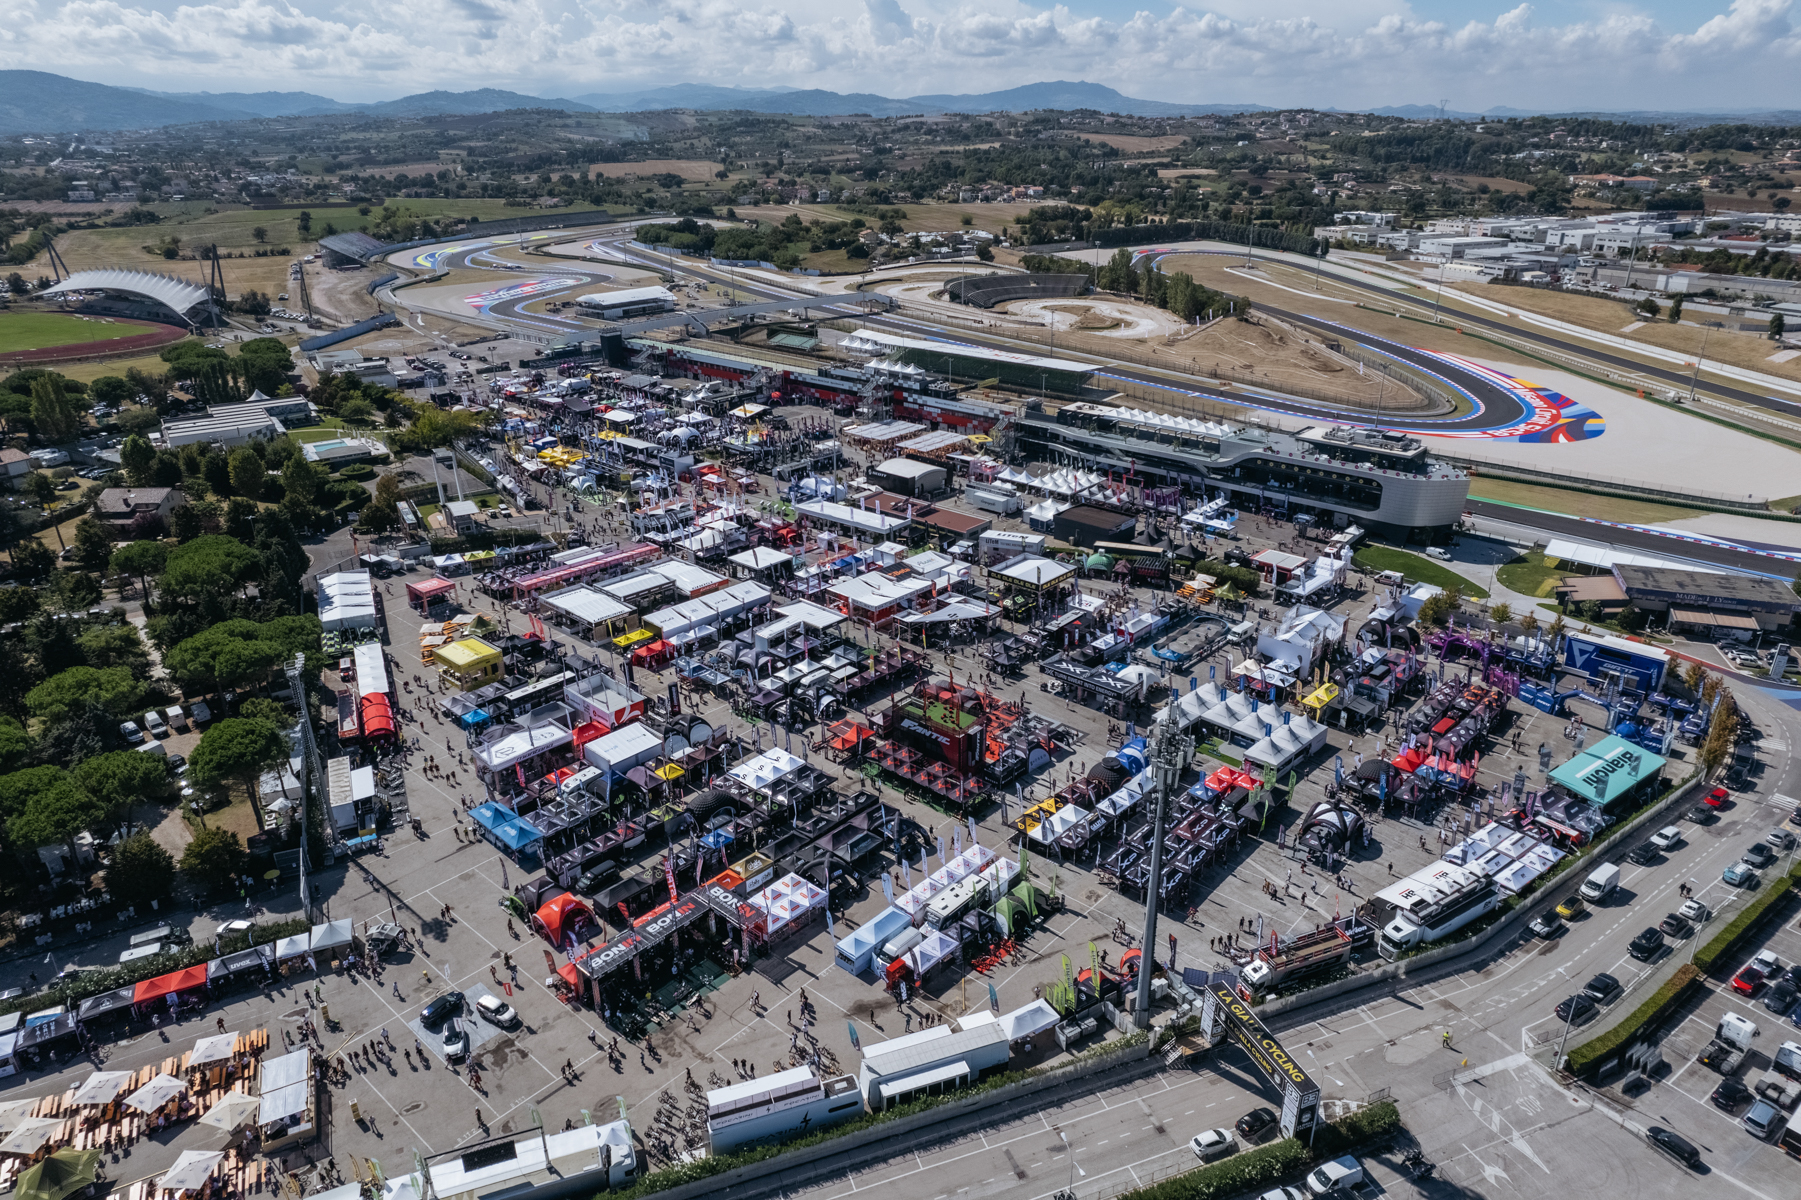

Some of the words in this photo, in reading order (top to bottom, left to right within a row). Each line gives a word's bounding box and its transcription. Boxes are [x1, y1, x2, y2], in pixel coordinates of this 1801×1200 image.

[900, 718, 951, 746] FANTIC
[646, 902, 696, 933] BONIN
[710, 886, 757, 918] BONIN
[230, 959, 251, 970] uvex
[591, 936, 641, 968] BONIN
[1218, 990, 1234, 1004] LA
[1231, 1004, 1265, 1039] GIALLA
[1262, 1039, 1305, 1082] CYCLING
[1227, 1019, 1234, 1030] LA
[1251, 1047, 1273, 1073] CYCLING
[1515, 1095, 1544, 1117] STOP
